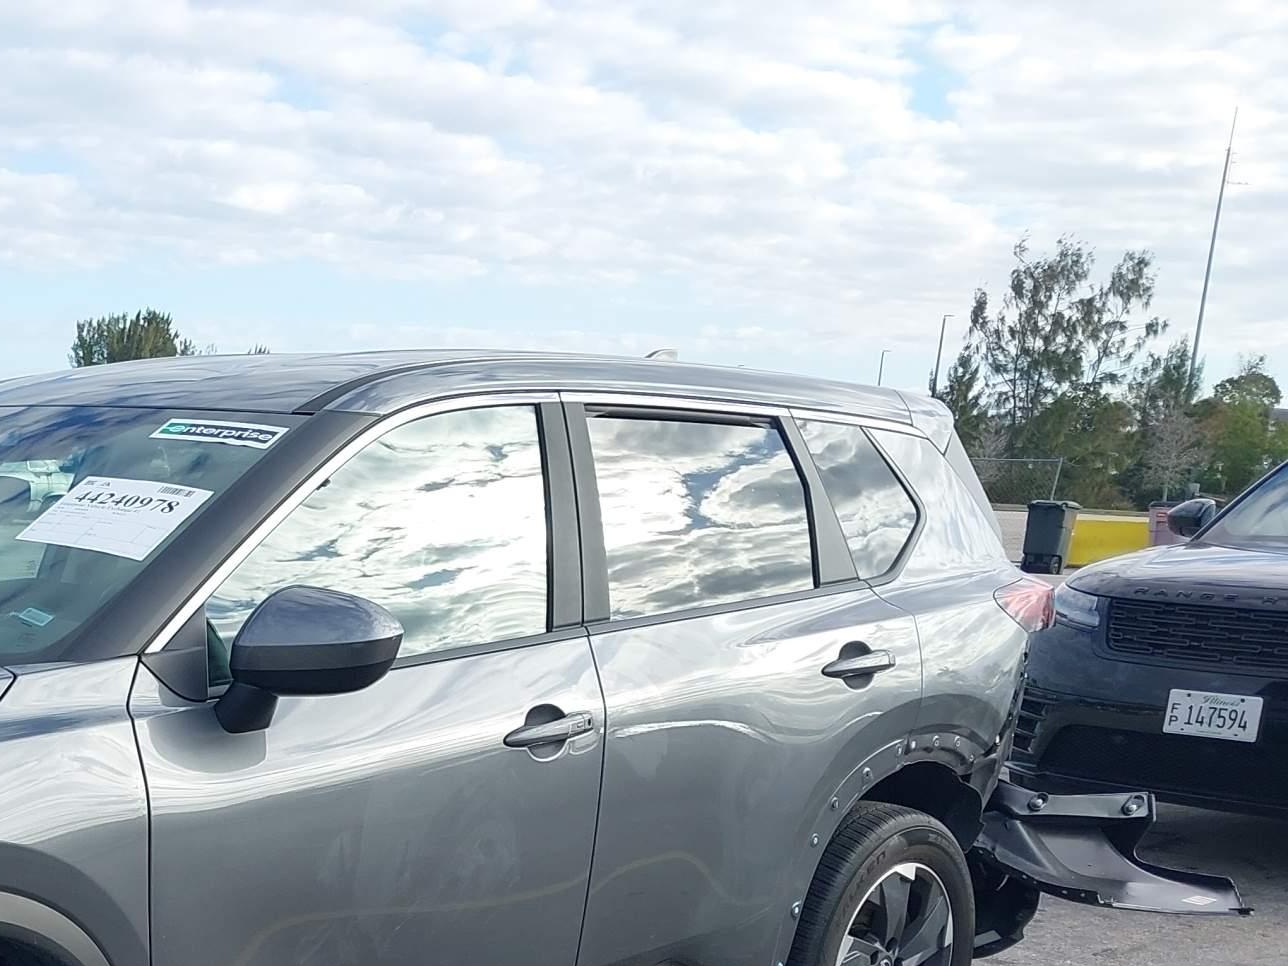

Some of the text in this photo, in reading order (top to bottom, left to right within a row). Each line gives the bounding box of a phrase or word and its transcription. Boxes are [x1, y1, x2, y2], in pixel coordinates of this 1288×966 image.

[168, 422, 274, 442] enterprise
[74, 489, 181, 514] 44240978
[1133, 587, 1240, 601] RANGE
[1202, 695, 1241, 708] Illinois
[1183, 704, 1248, 732] 147594
